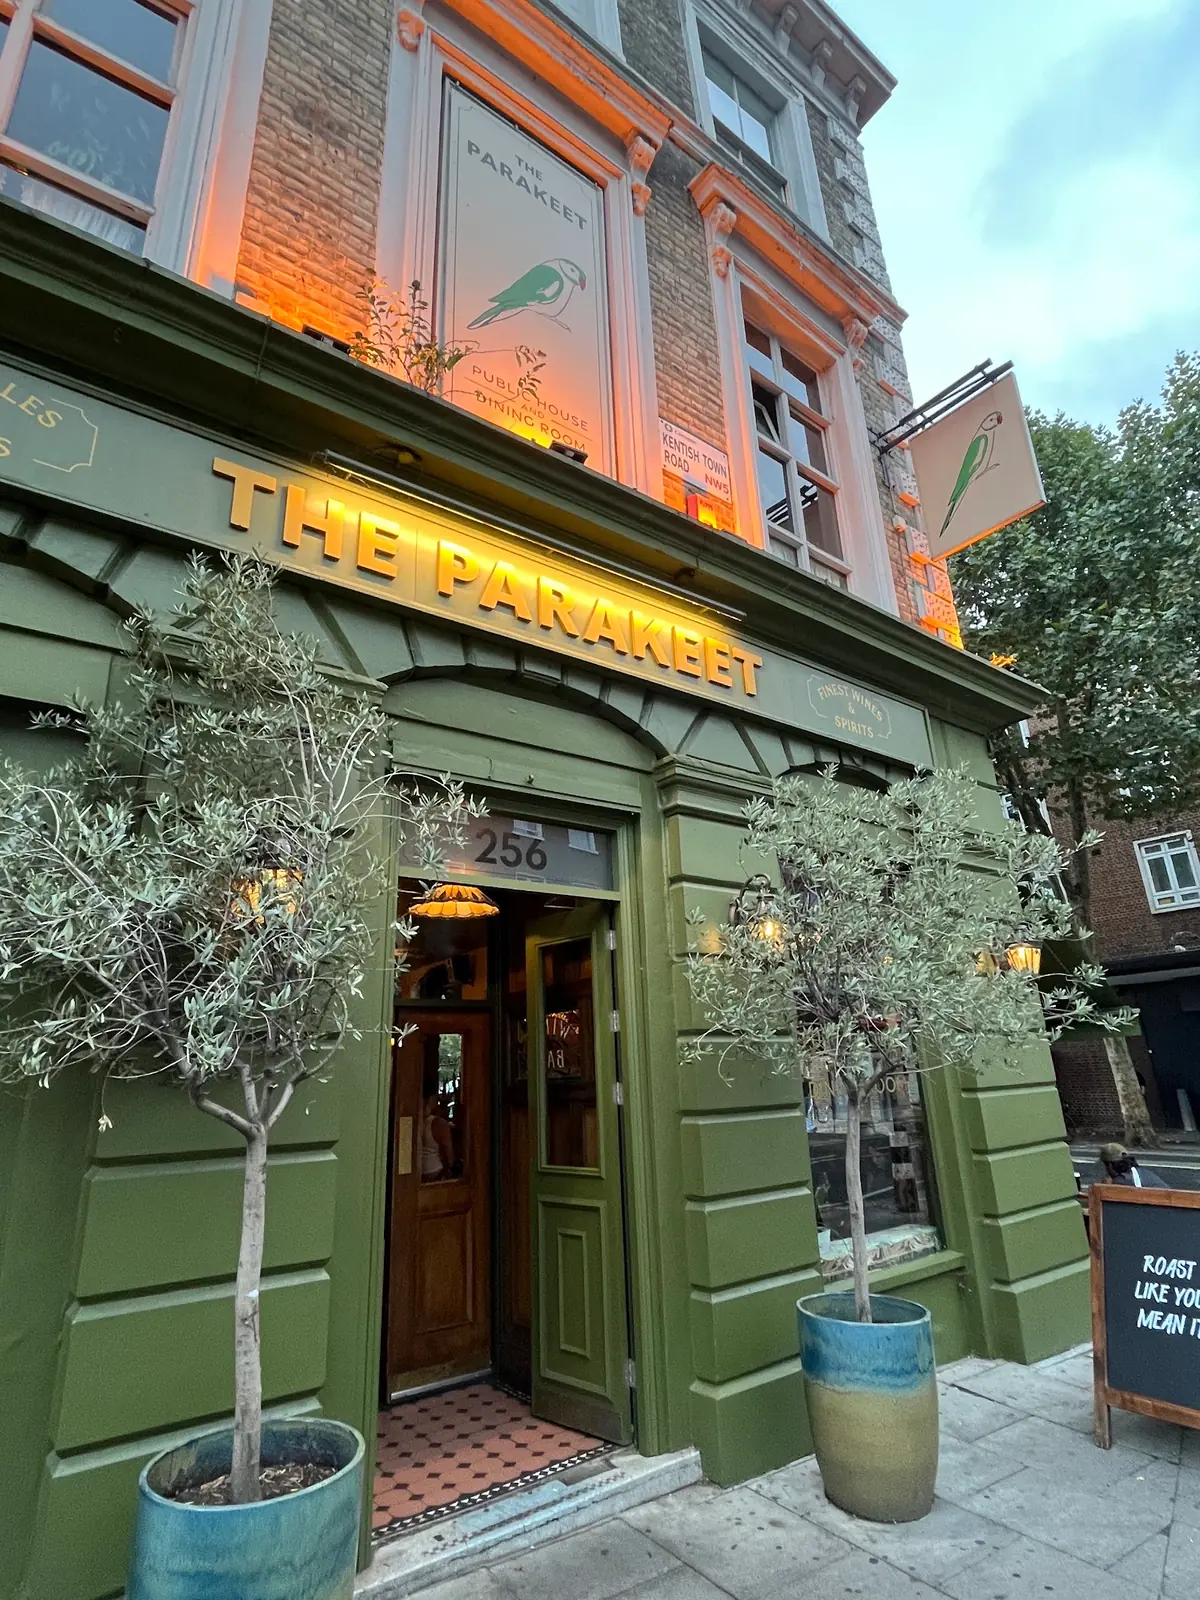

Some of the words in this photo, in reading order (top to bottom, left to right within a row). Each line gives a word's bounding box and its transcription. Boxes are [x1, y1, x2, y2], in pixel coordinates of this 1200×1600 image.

[514, 154, 543, 182] THE
[467, 139, 588, 231] PARAKEET
[472, 364, 532, 402] PUBLIC
[537, 397, 588, 432] HOUSE
[521, 403, 545, 419] AND
[476, 391, 534, 427] DINING
[540, 422, 586, 451] ROOM
[662, 432, 700, 463] KENTISH
[702, 454, 727, 478] TOWN
[664, 449, 690, 473] ROAD
[704, 473, 729, 494] NW5
[212, 457, 400, 580] THE
[436, 538, 763, 697] PARAKEET
[817, 683, 849, 700] FINEST
[851, 688, 883, 721] WINES
[848, 702, 855, 714] &
[834, 715, 874, 739] SPIRITS
[475, 828, 548, 870] 256
[1143, 1254, 1197, 1280] ROAST
[1134, 1280, 1171, 1303] LIKE
[1136, 1307, 1187, 1335] MEAN
